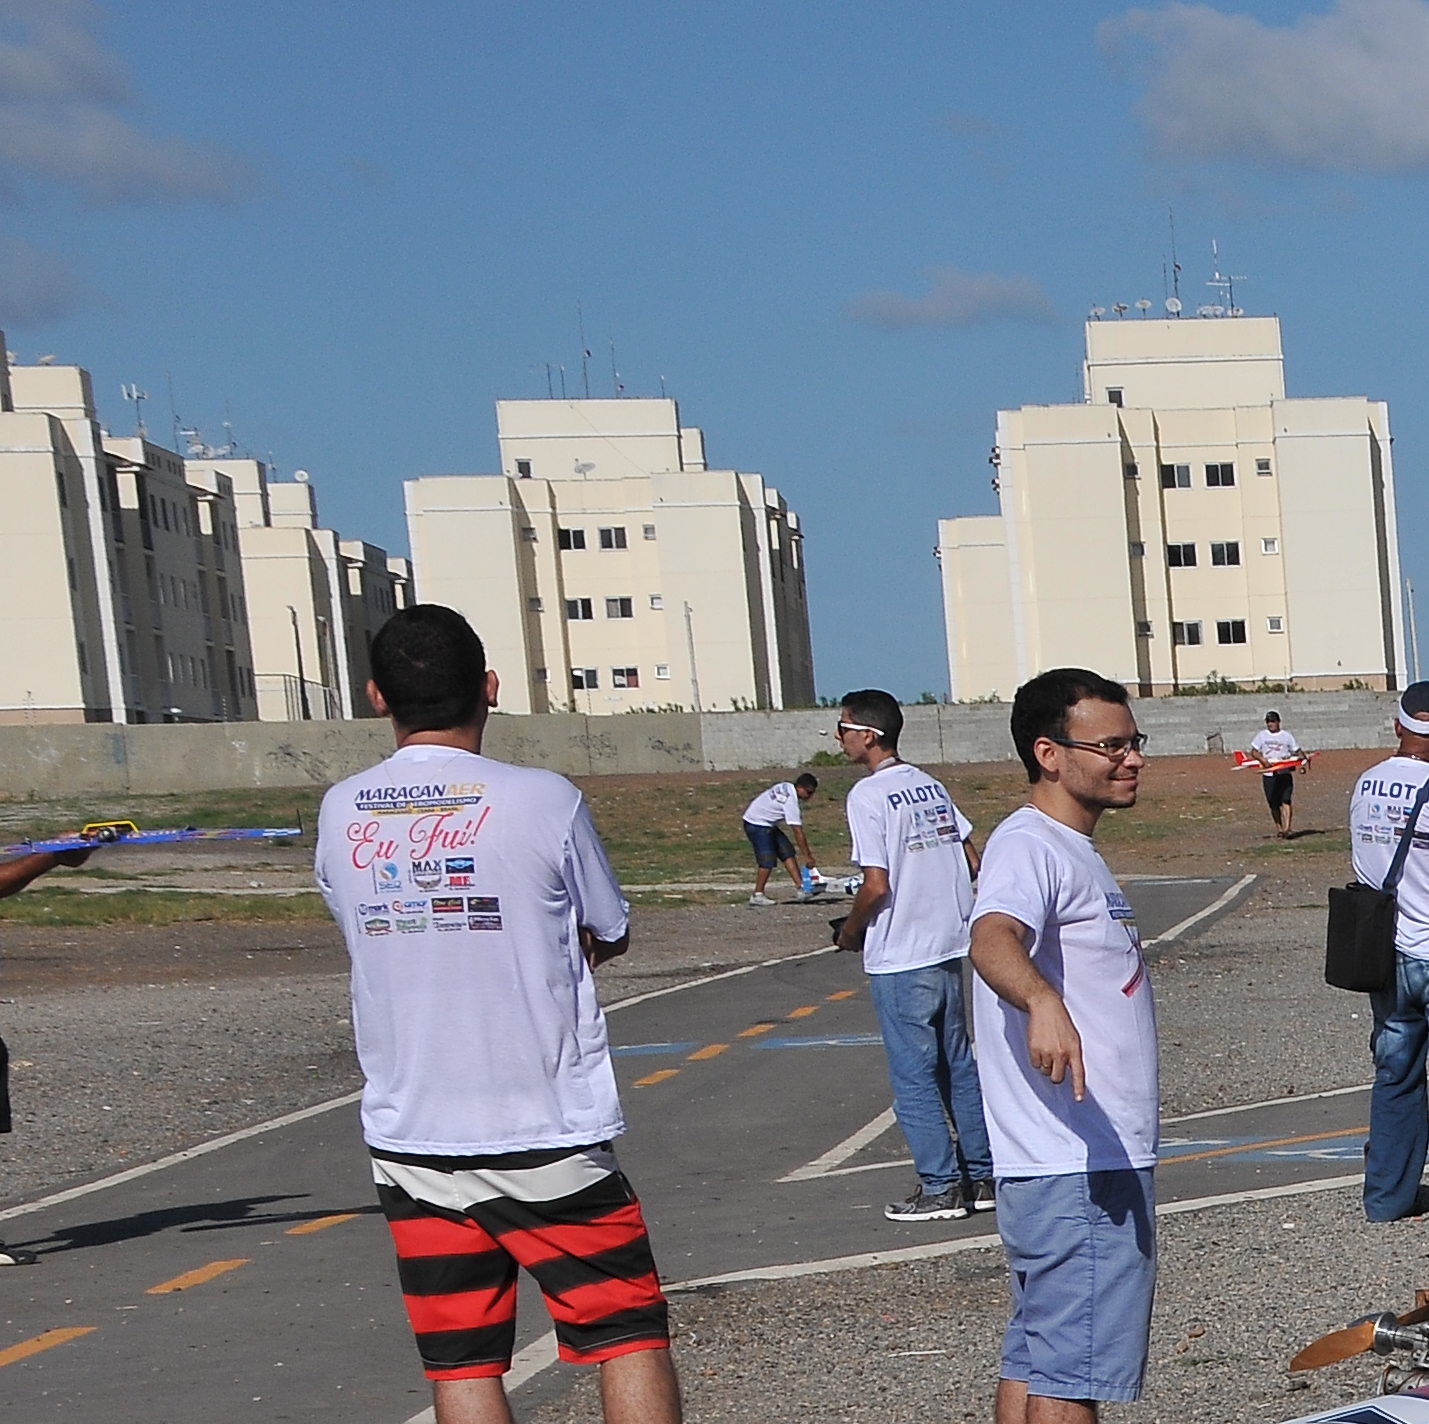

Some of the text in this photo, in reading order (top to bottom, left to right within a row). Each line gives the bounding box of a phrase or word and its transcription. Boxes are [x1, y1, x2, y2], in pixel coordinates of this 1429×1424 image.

[354, 783, 486, 801] MARACANAER
[888, 784, 946, 811] PILOTO
[1360, 780, 1417, 800] PILOT
[346, 805, 491, 870] Eu Fui!
[412, 859, 442, 873] MAX
